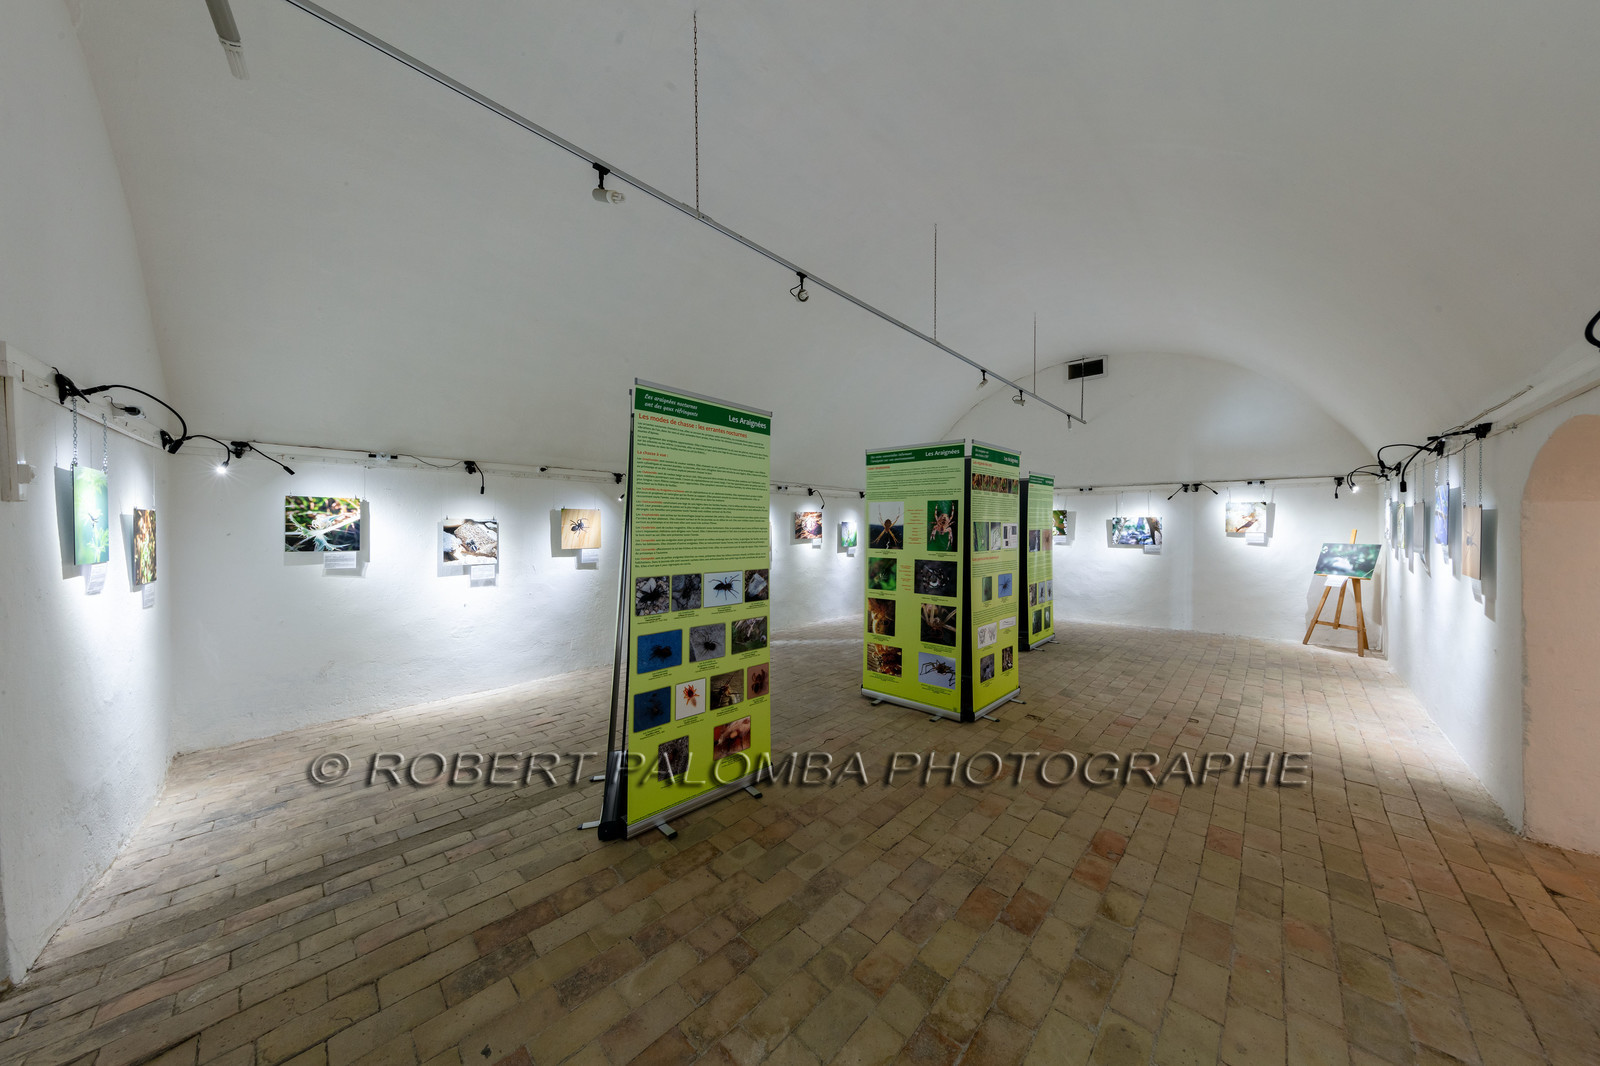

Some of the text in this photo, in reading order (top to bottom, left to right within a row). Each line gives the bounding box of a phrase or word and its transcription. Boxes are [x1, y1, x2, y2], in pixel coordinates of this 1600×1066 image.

[677, 402, 698, 410] nocturnes
[638, 412, 649, 420] Les
[650, 415, 669, 424] modes
[678, 420, 695, 429] chasse
[706, 426, 726, 434] errantes
[726, 430, 748, 438] nocturnes
[728, 414, 767, 429] Les Araignées
[934, 448, 960, 458] Araignées
